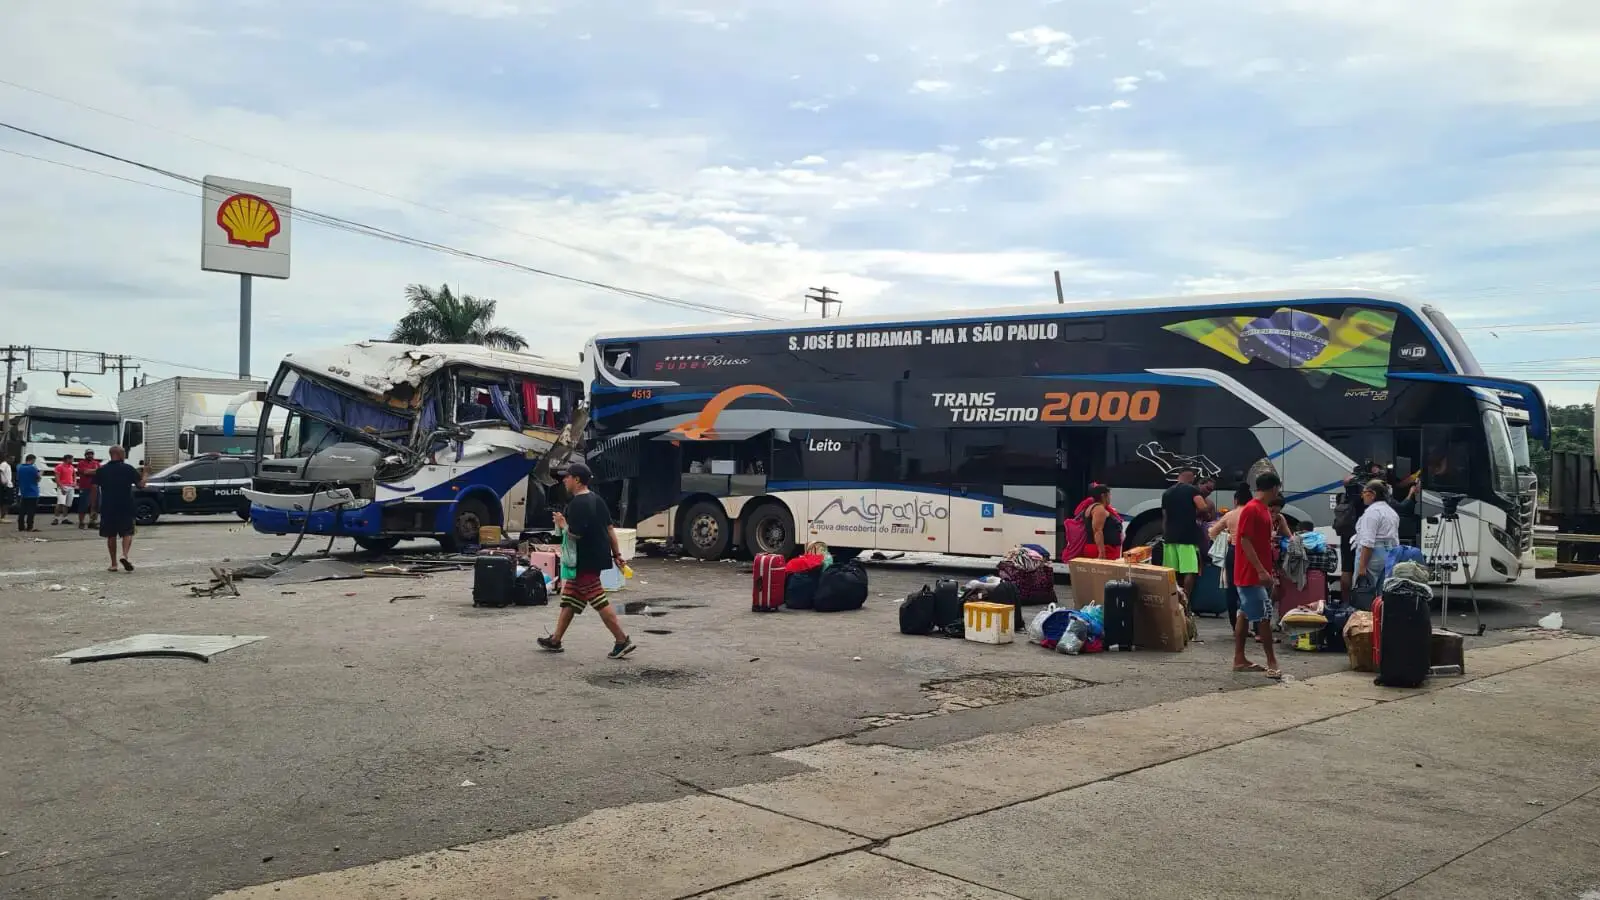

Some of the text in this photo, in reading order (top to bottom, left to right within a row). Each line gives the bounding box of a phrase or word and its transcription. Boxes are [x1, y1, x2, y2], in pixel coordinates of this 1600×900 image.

[788, 336, 800, 351] S.
[802, 331, 834, 350] JOSÉ
[836, 333, 854, 349] DE
[856, 330, 922, 348] RIBAMAR
[957, 327, 968, 343] X
[972, 323, 1004, 342] SÃO
[1007, 323, 1058, 341] PAULO
[631, 389, 652, 399] 4513
[932, 392, 996, 407] TRANS
[950, 390, 1161, 422] TURISMO 2000
[809, 438, 841, 451] Leito
[813, 496, 949, 534] Maranhão
[816, 523, 835, 531] nova
[835, 523, 877, 533] descoberta
[879, 524, 890, 533] do
[890, 524, 914, 534] Brasil
